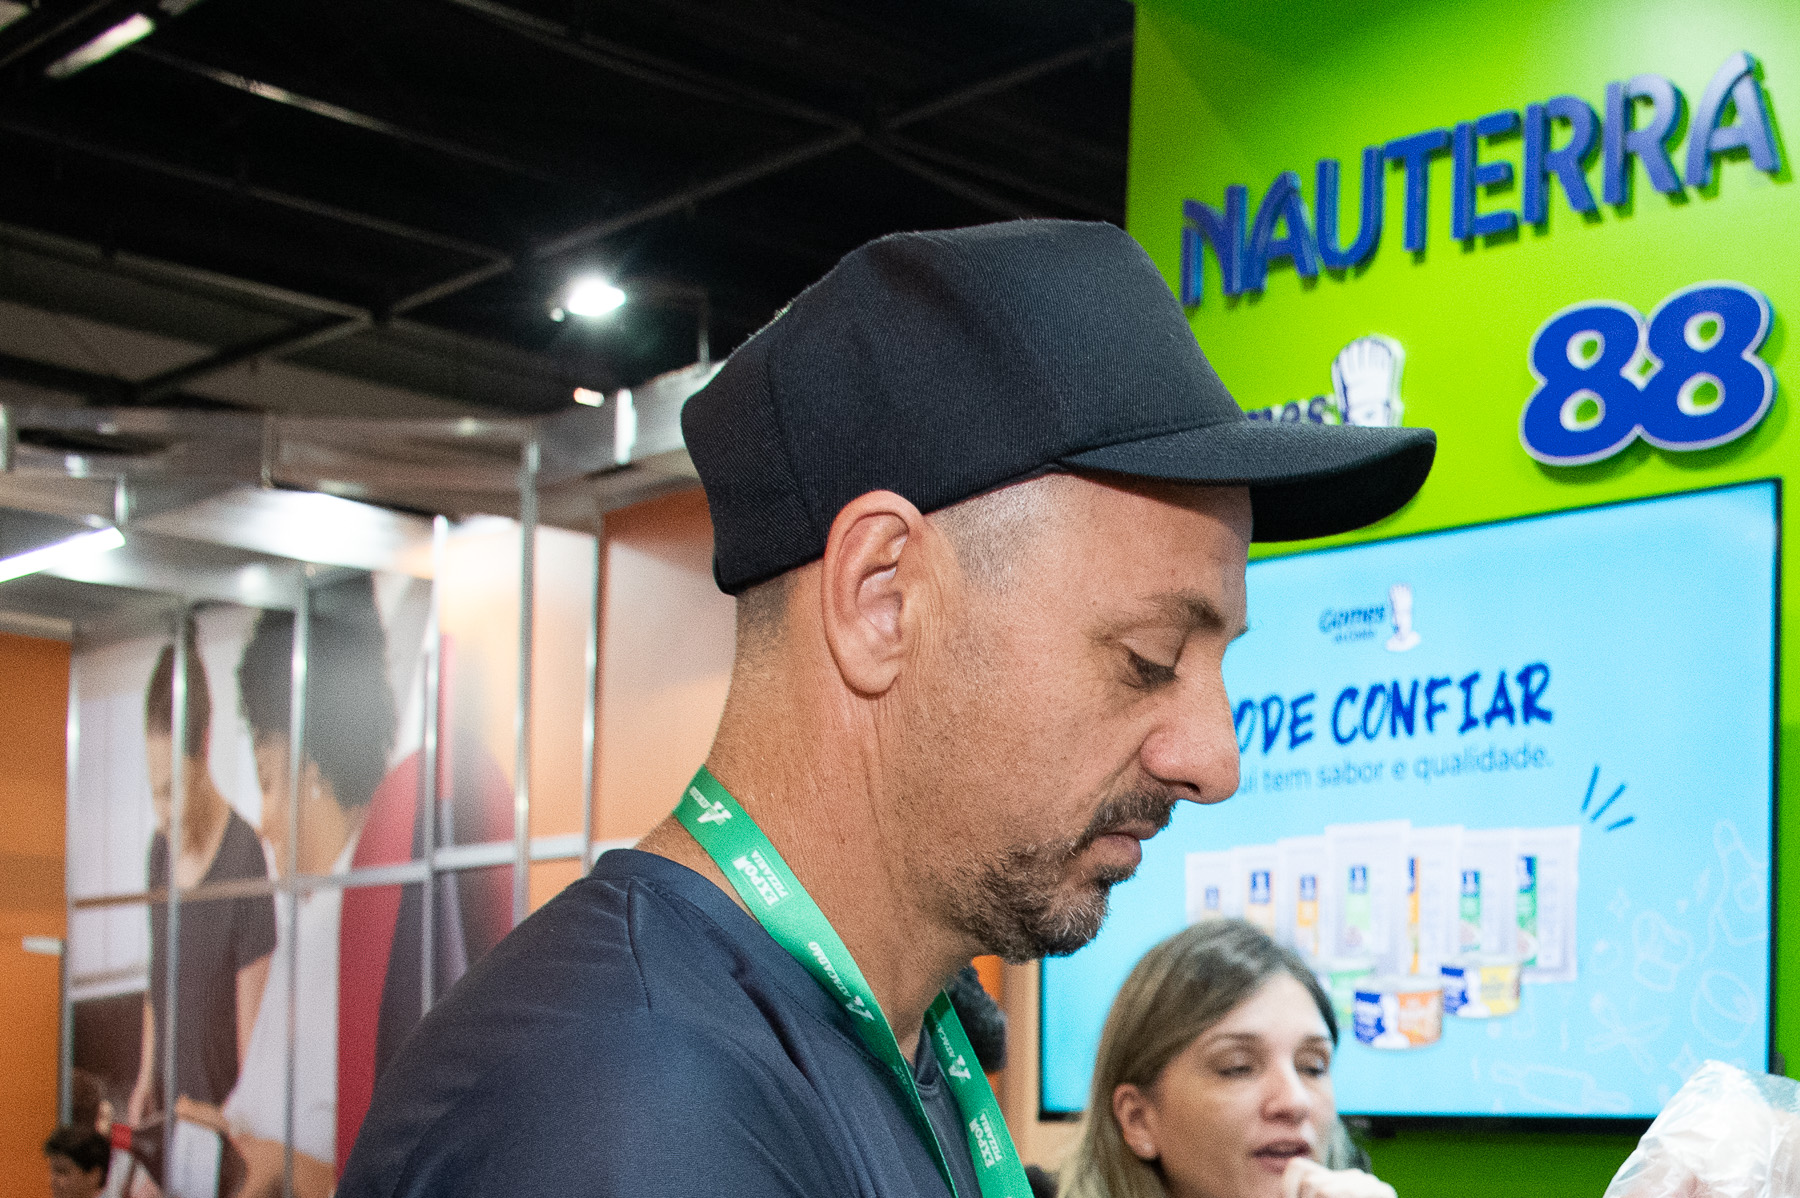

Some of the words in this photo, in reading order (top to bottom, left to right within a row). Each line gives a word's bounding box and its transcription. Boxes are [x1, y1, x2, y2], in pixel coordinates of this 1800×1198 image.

[1181, 51, 1783, 307] NAUTERRA
[1519, 281, 1777, 467] 88
[1233, 692, 1316, 756] ODE
[1331, 661, 1555, 746] CONFIAR
[1263, 767, 1312, 793] tem
[1316, 759, 1384, 788] sabor
[1391, 758, 1408, 782] e
[1413, 742, 1554, 786] qualidade.
[744, 863, 780, 907] EXPO
[751, 849, 789, 898] PIZZARIA
[974, 1126, 996, 1168] EXPO
